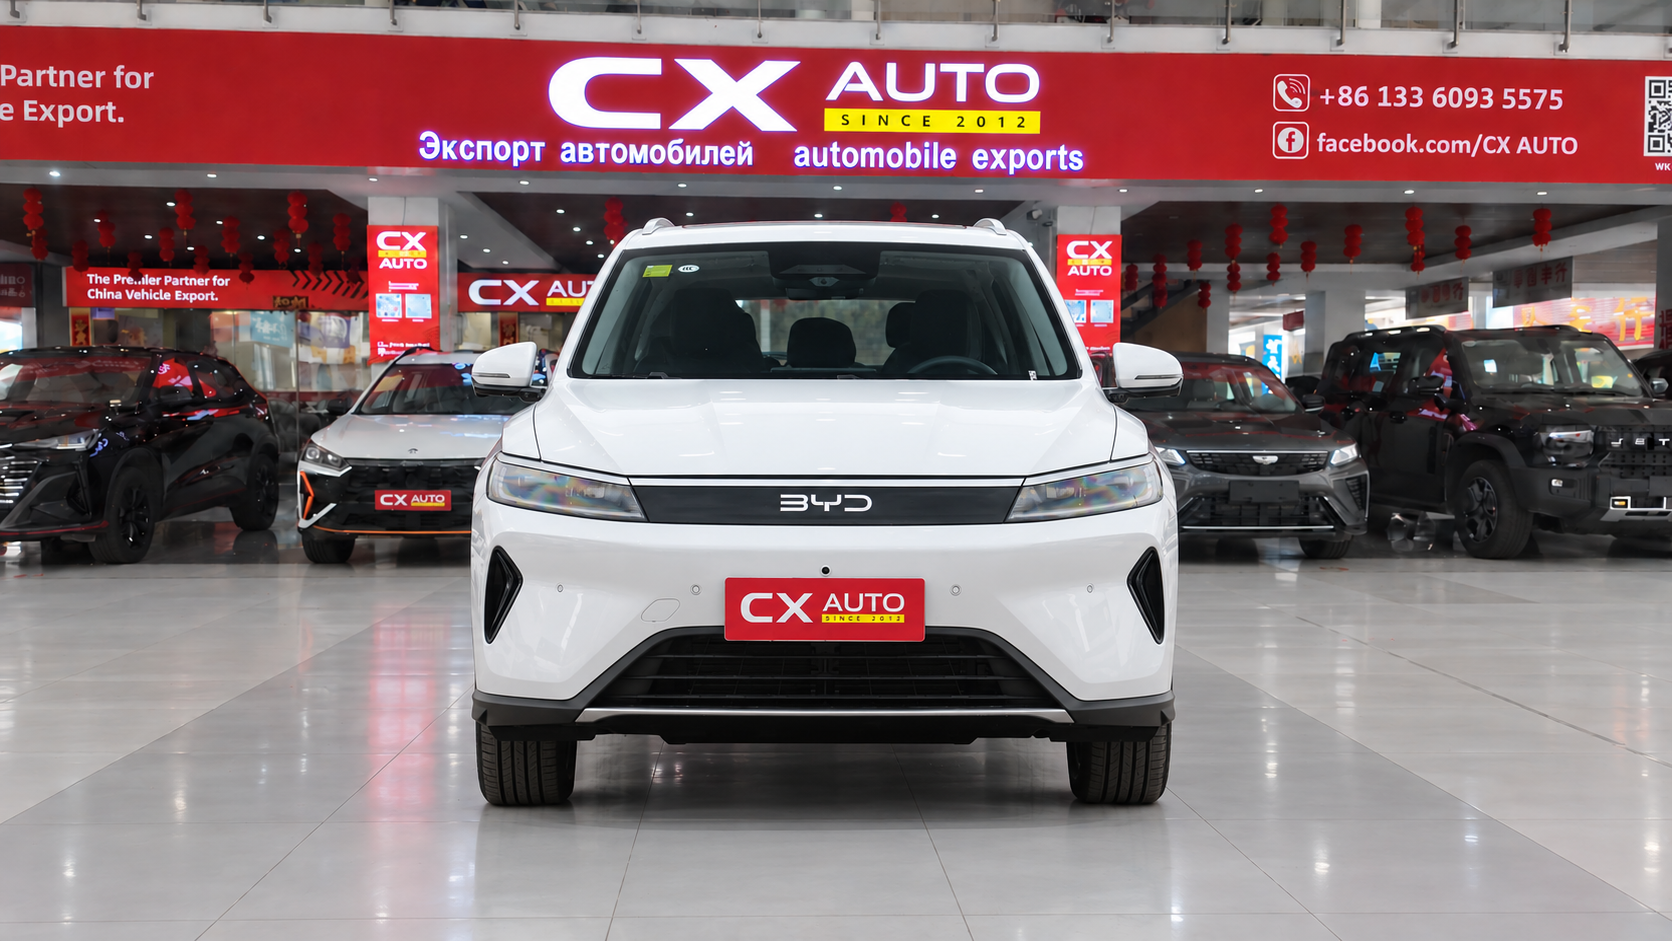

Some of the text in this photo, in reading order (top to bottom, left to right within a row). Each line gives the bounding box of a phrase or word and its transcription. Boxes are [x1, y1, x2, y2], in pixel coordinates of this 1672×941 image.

[0, 64, 154, 89] Partner for
[548, 56, 1040, 132] CX AUTO
[1319, 85, 1563, 110] +86 133 6093 5575
[23, 99, 124, 128] Export.
[841, 114, 1026, 128] SINCE 2012
[419, 130, 754, 167] Экспорт автомобилей
[1316, 132, 1578, 158] facebook.com/CX AUTO
[793, 141, 1084, 175] automobile exports
[376, 231, 427, 251] CX
[1066, 240, 1113, 260] CX
[379, 258, 428, 270] AUTO
[1067, 265, 1112, 276] AUTO
[87, 274, 110, 285] The
[164, 275, 210, 287] Partner
[212, 275, 231, 287] for
[87, 288, 219, 303] China Vehicle Export.
[468, 279, 540, 306] CX
[380, 493, 446, 506] CX AUTO
[780, 494, 873, 512] BYD
[740, 592, 906, 624] CX AUTO
